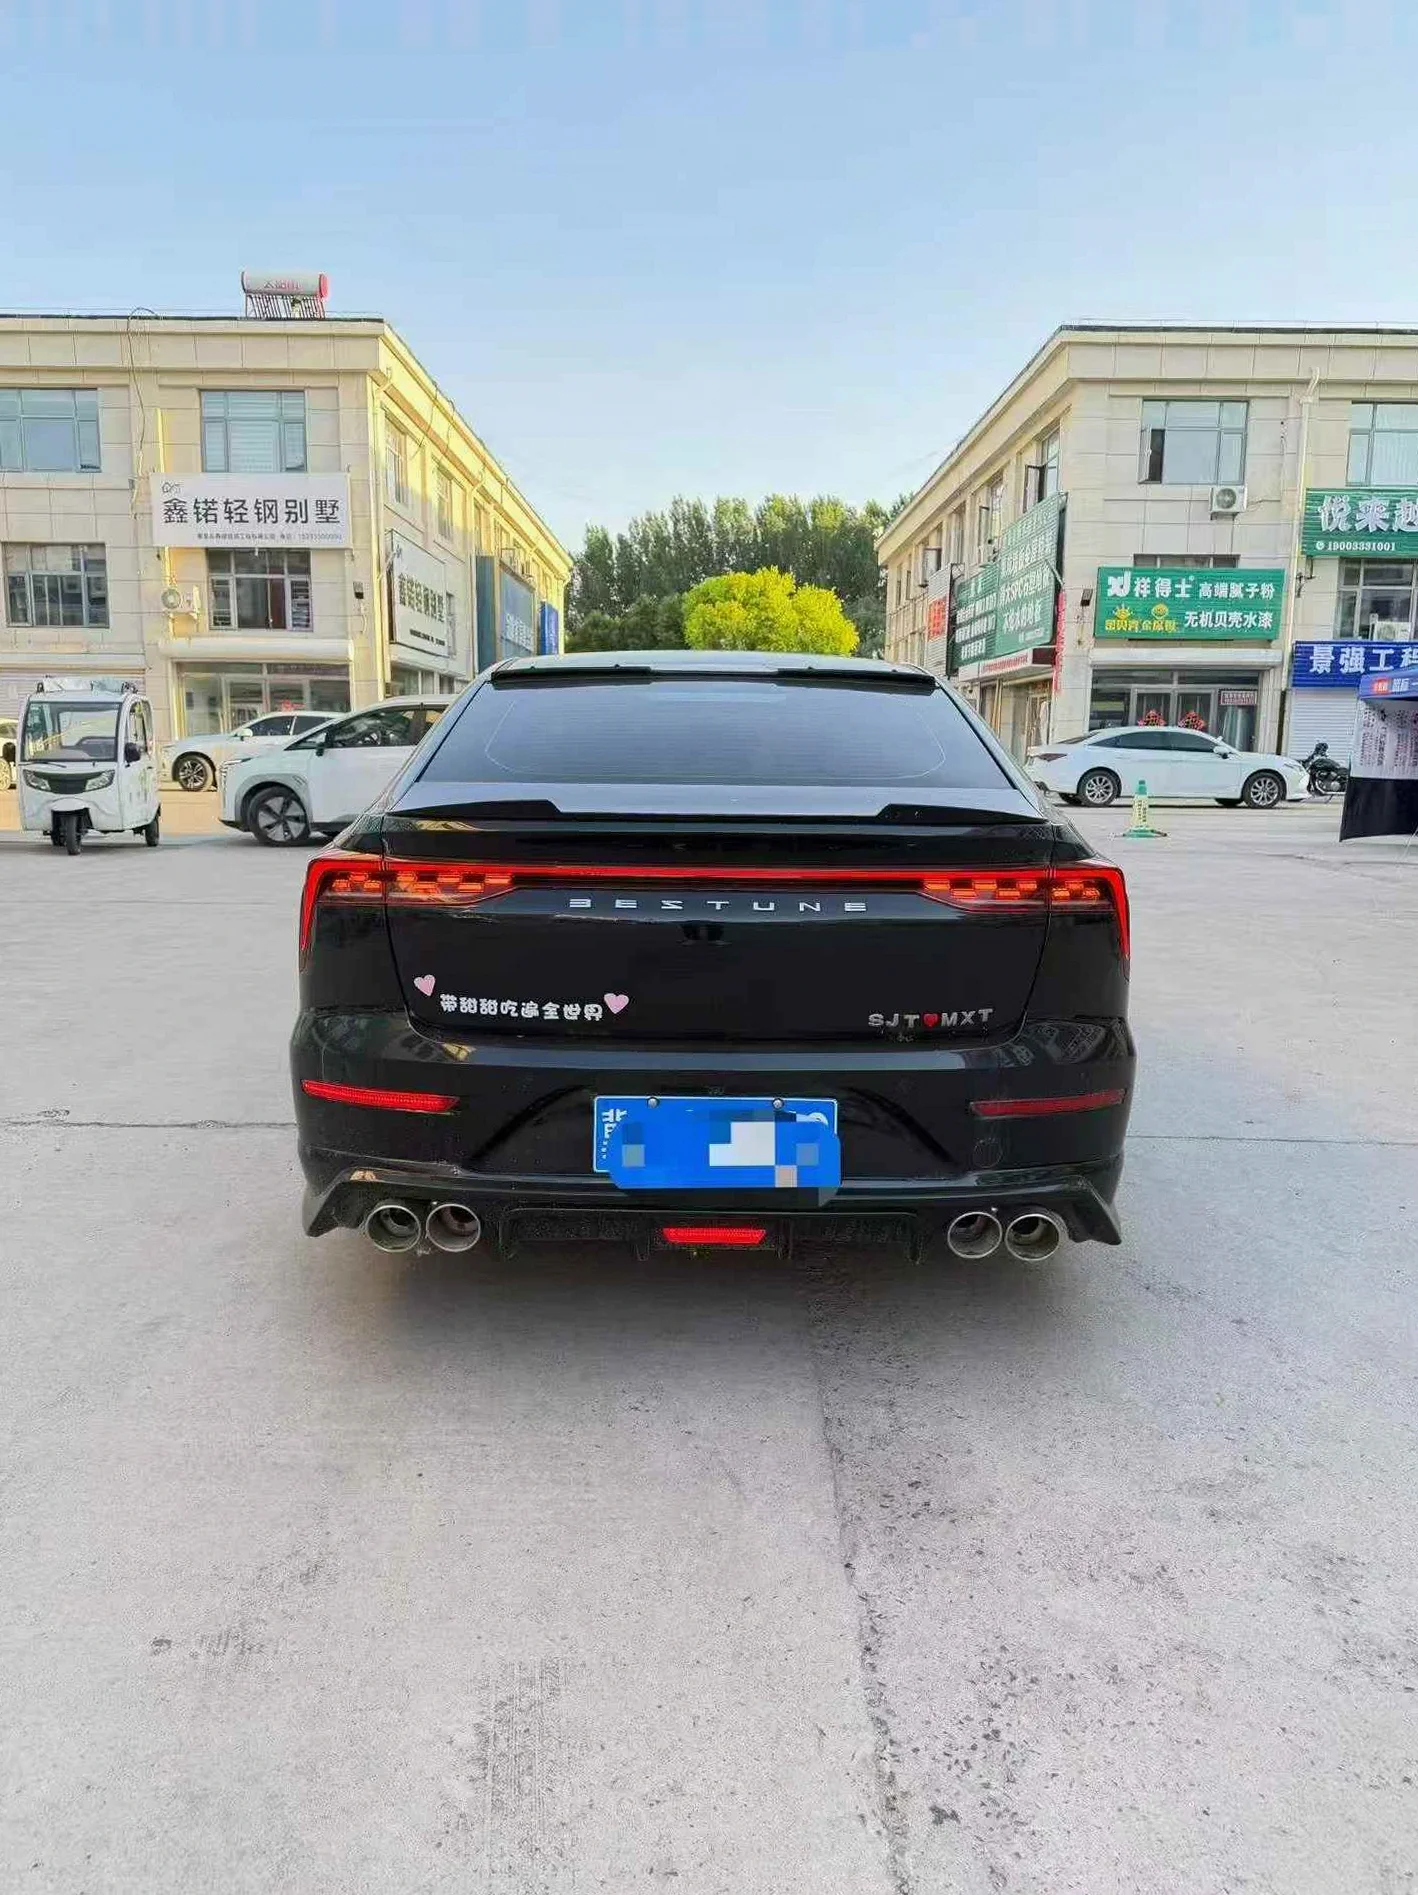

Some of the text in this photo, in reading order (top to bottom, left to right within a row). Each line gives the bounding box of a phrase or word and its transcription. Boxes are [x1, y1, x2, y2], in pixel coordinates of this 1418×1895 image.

[569, 898, 867, 912] BESTUNE
[440, 993, 604, 1022] 带甜甜吃遍全世界
